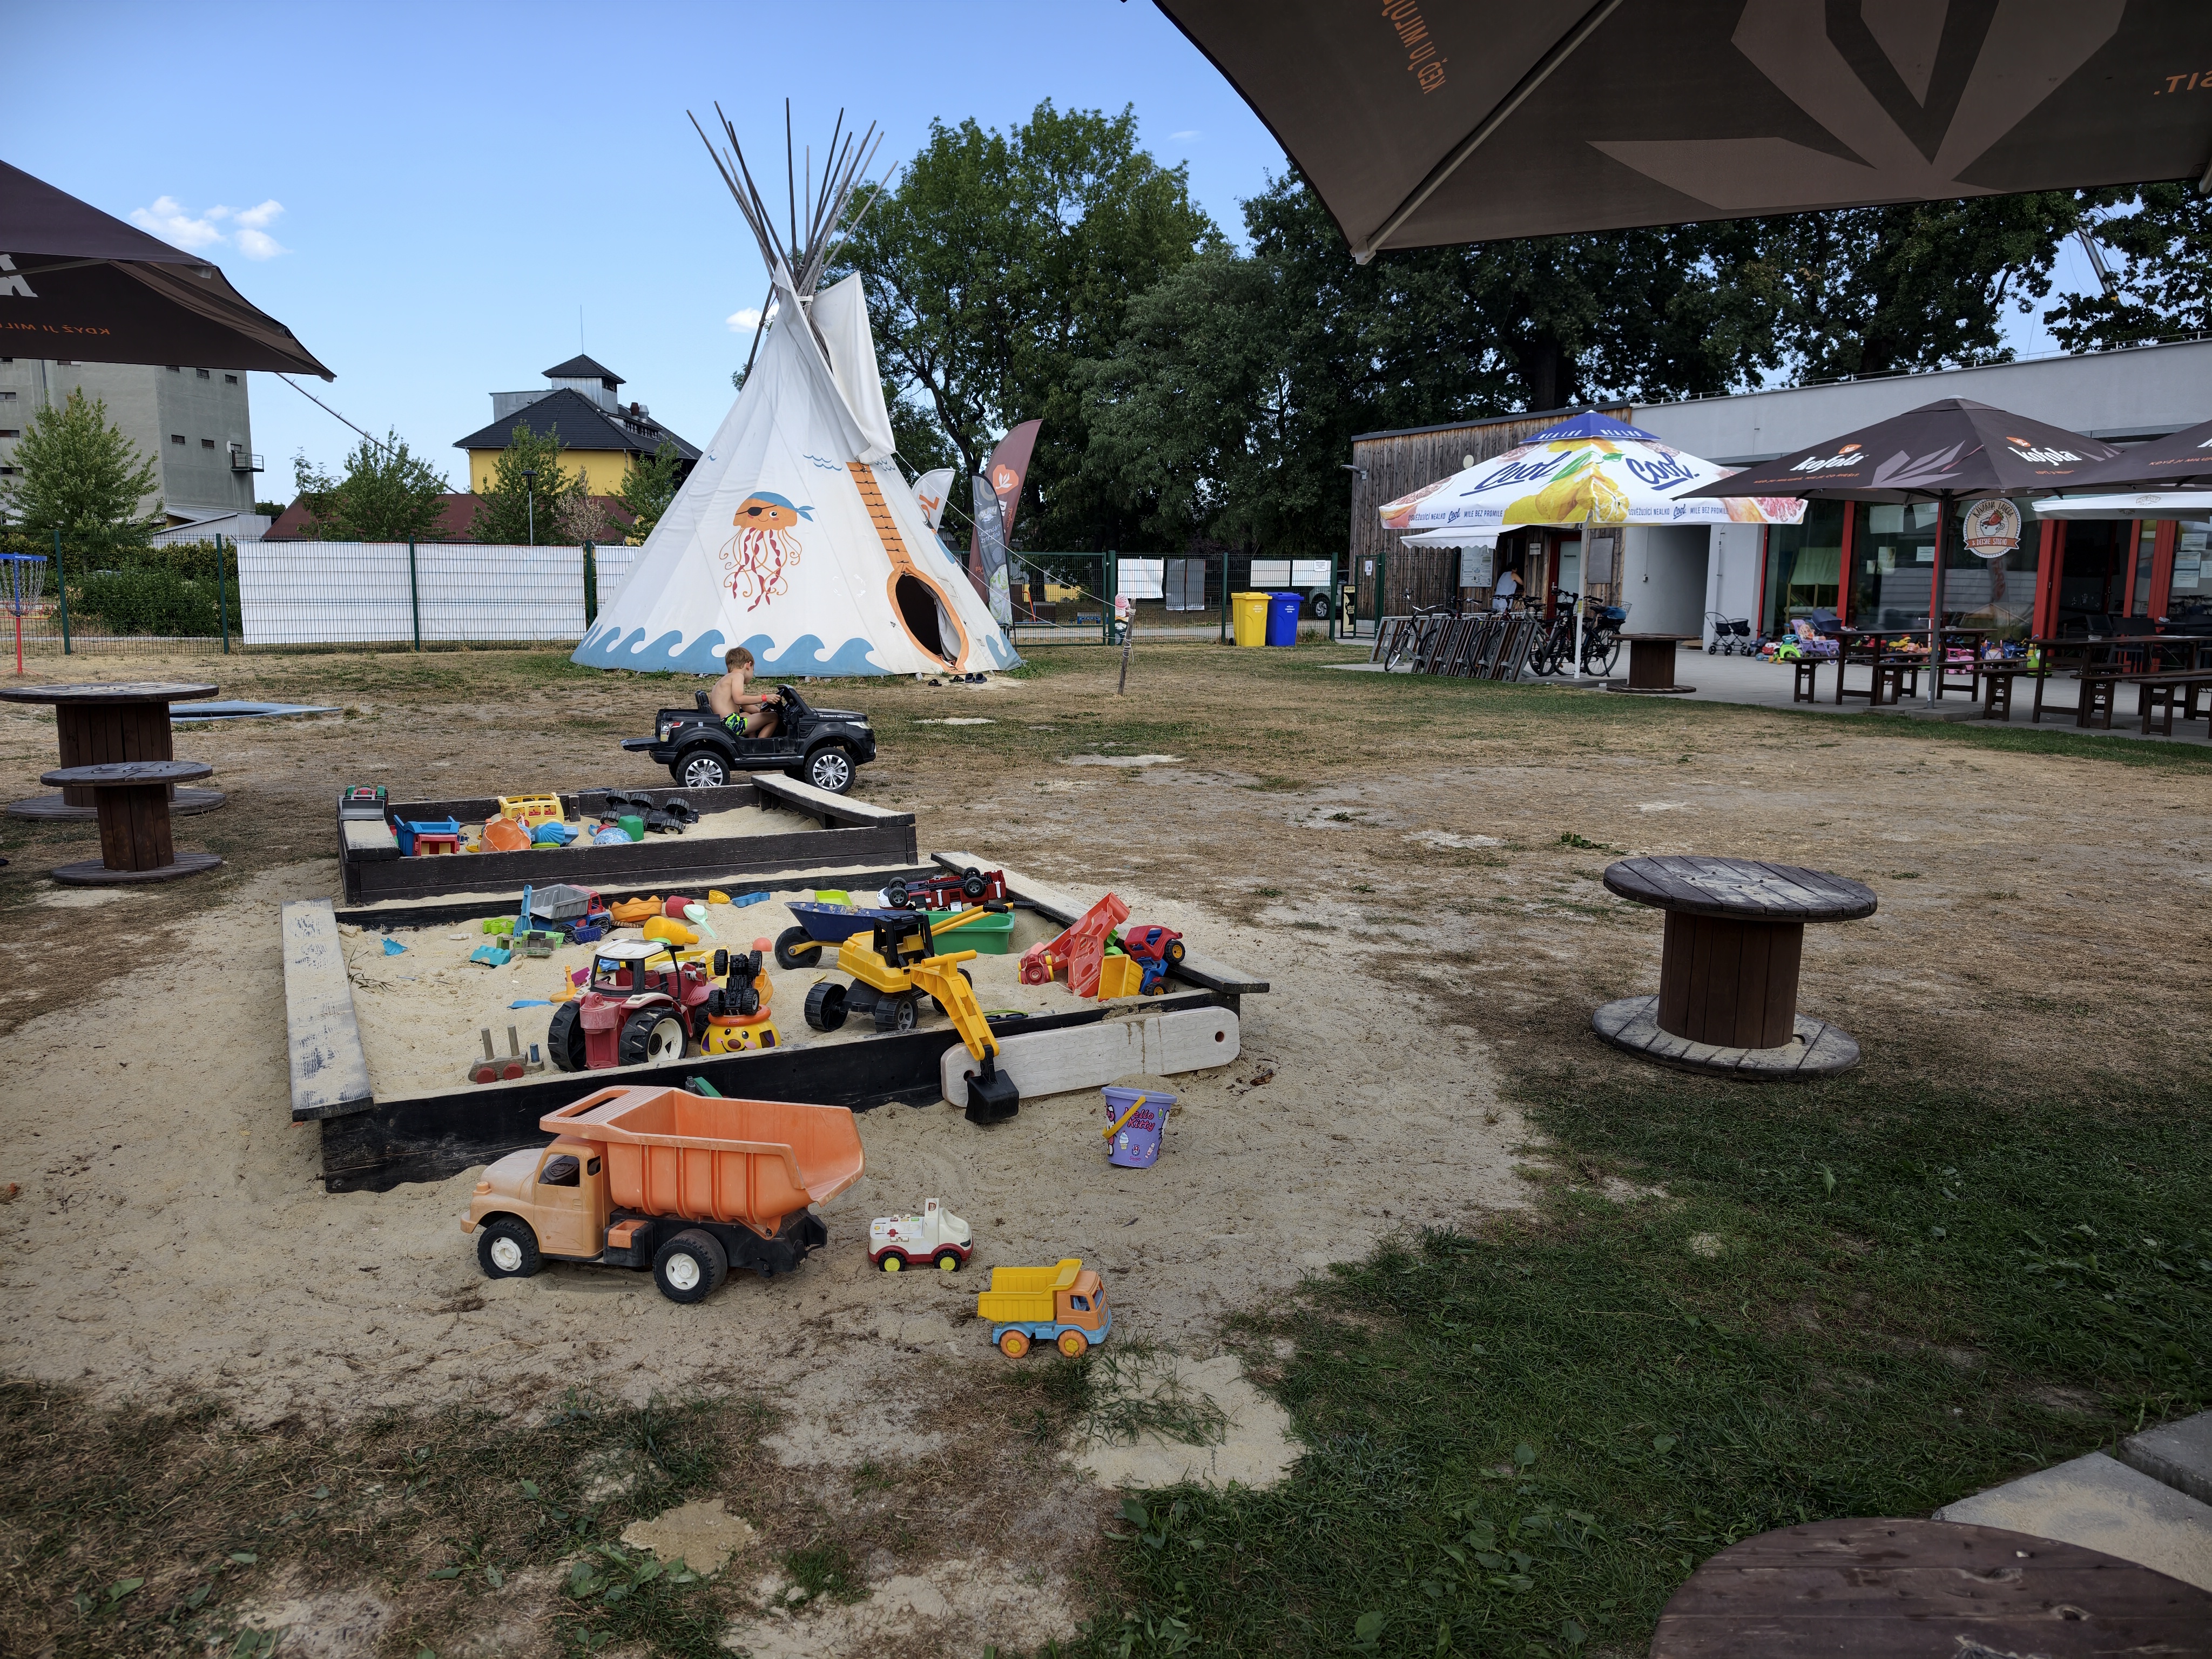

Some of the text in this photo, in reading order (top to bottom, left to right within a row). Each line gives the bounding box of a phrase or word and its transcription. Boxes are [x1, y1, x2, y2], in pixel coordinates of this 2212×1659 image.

[1537, 429, 1583, 440] NEALKO
[1600, 429, 1642, 437] NEALKO
[1789, 453, 1865, 474] kofola
[2008, 447, 2083, 466] kofola
[1127, 1117, 1156, 1132] Kitty
